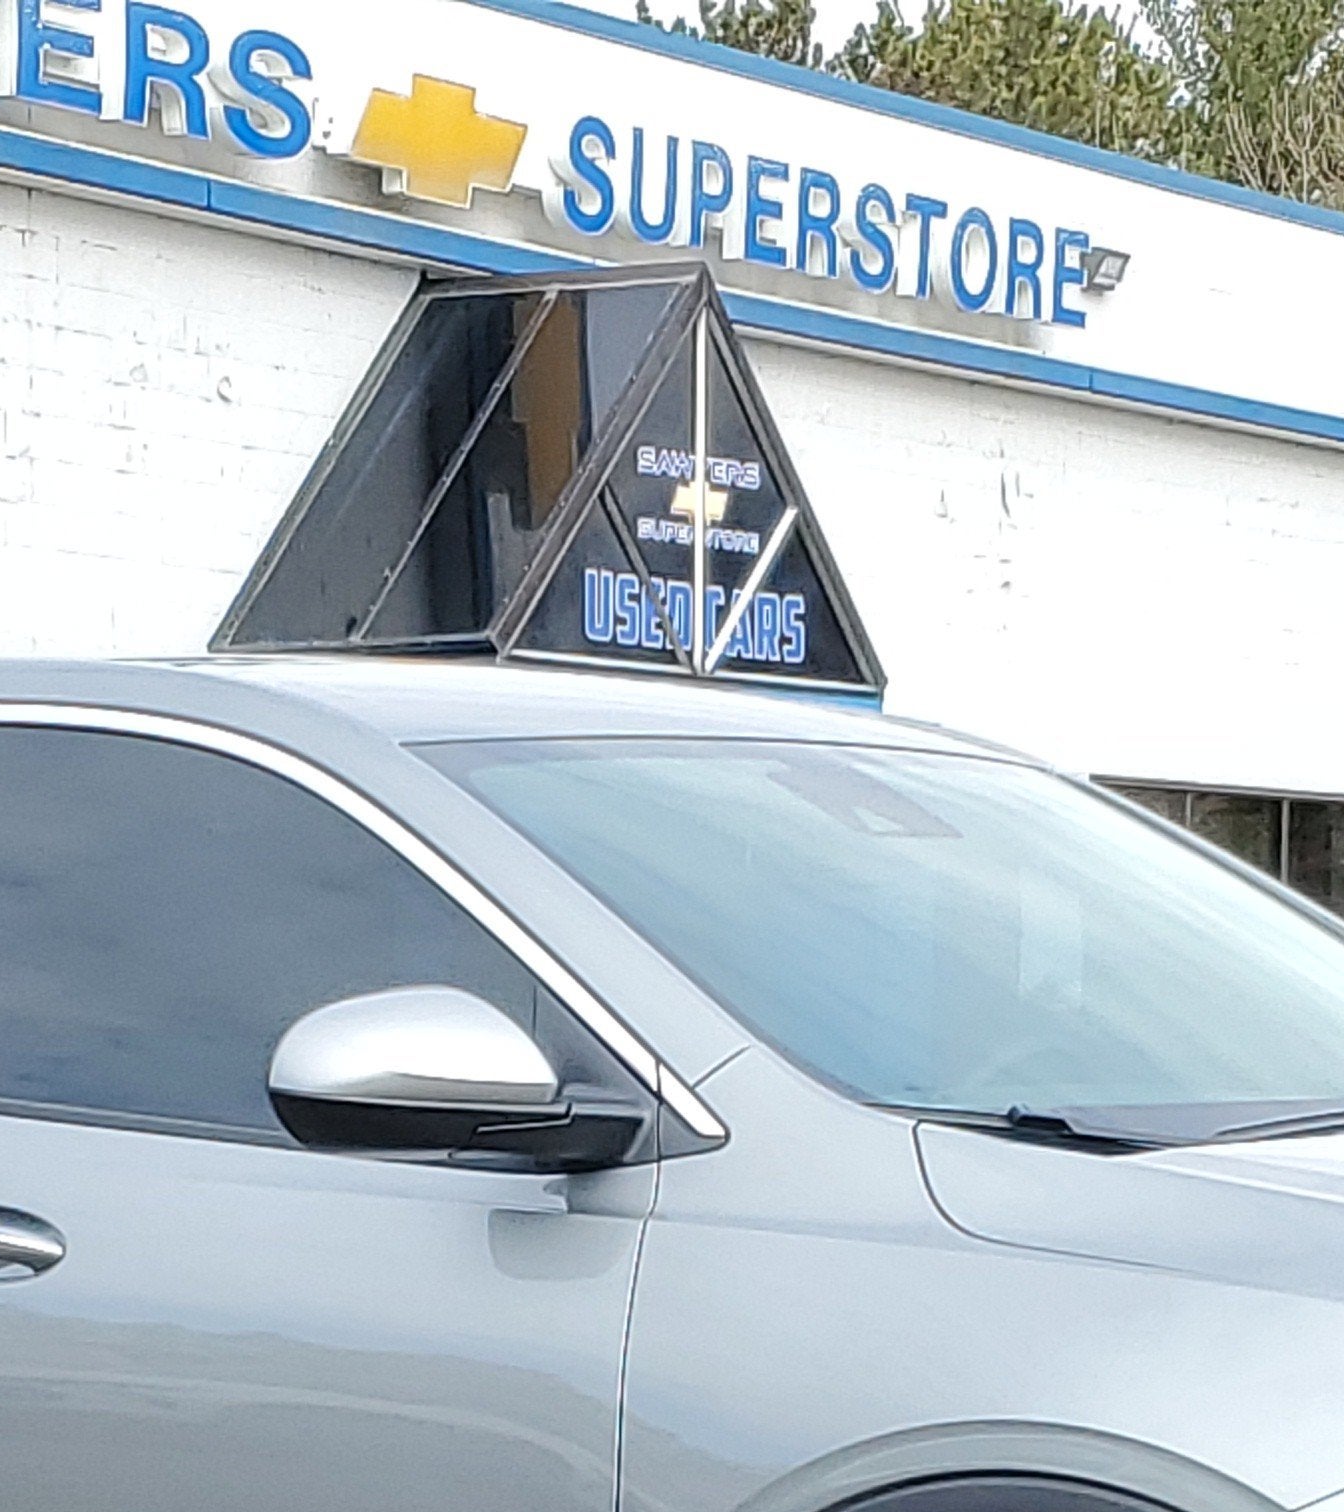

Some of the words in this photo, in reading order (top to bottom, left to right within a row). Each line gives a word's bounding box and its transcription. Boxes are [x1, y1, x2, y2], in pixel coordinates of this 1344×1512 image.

[560, 115, 1094, 328] SUPERSTORE
[636, 445, 762, 491] SAWERS
[584, 567, 695, 652] USED
